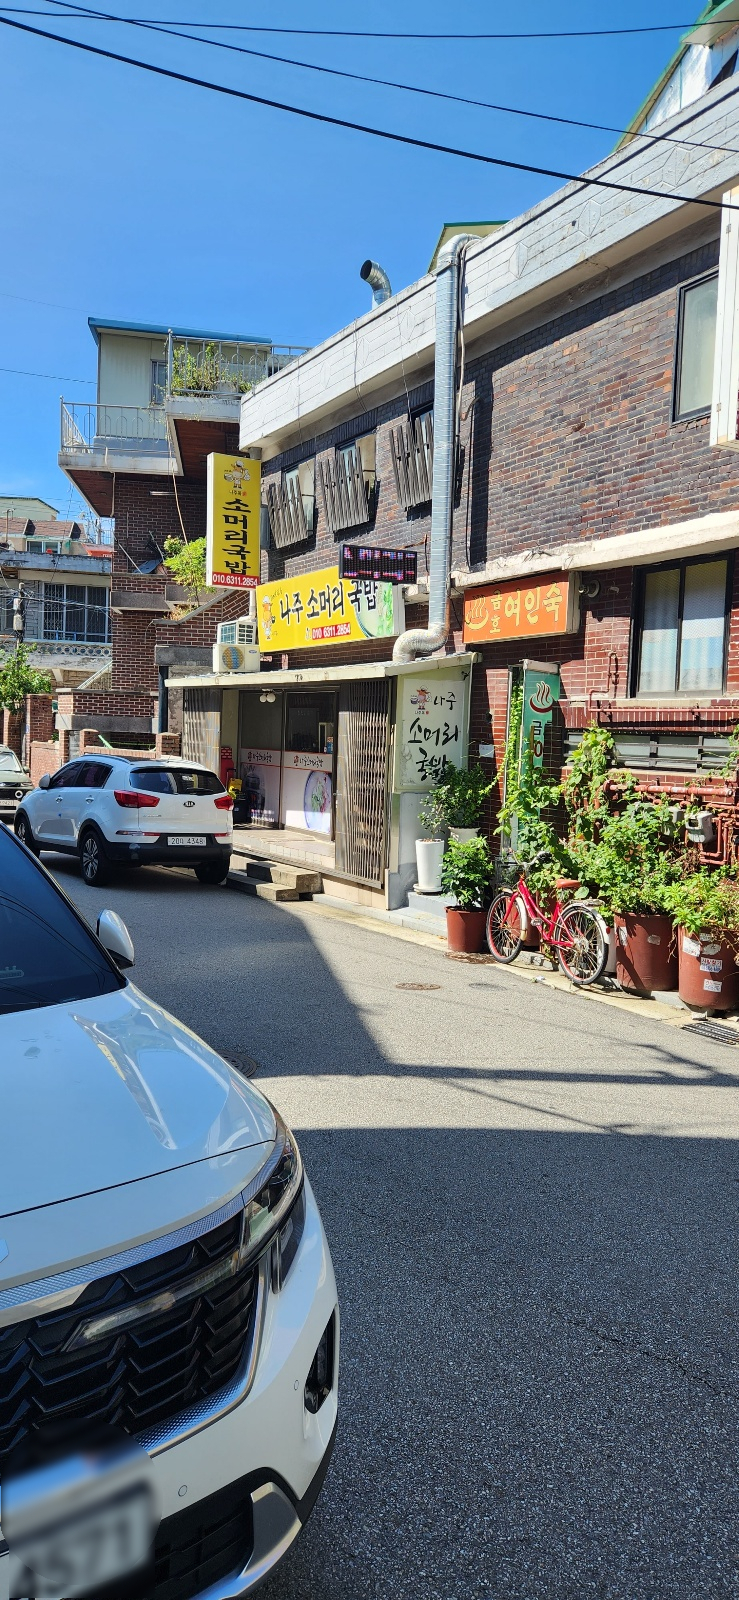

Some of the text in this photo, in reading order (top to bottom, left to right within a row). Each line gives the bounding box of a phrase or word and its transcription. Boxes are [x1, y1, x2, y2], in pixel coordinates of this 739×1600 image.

[222, 498, 251, 575] 소머리국밥
[212, 573, 258, 587] 010.6311.2854
[280, 592, 304, 625] 나주
[307, 581, 345, 619] 소머리
[348, 579, 378, 612] 국밥
[504, 582, 564, 626] 여인숙
[433, 691, 457, 711] 나주
[407, 716, 459, 747] 소머리
